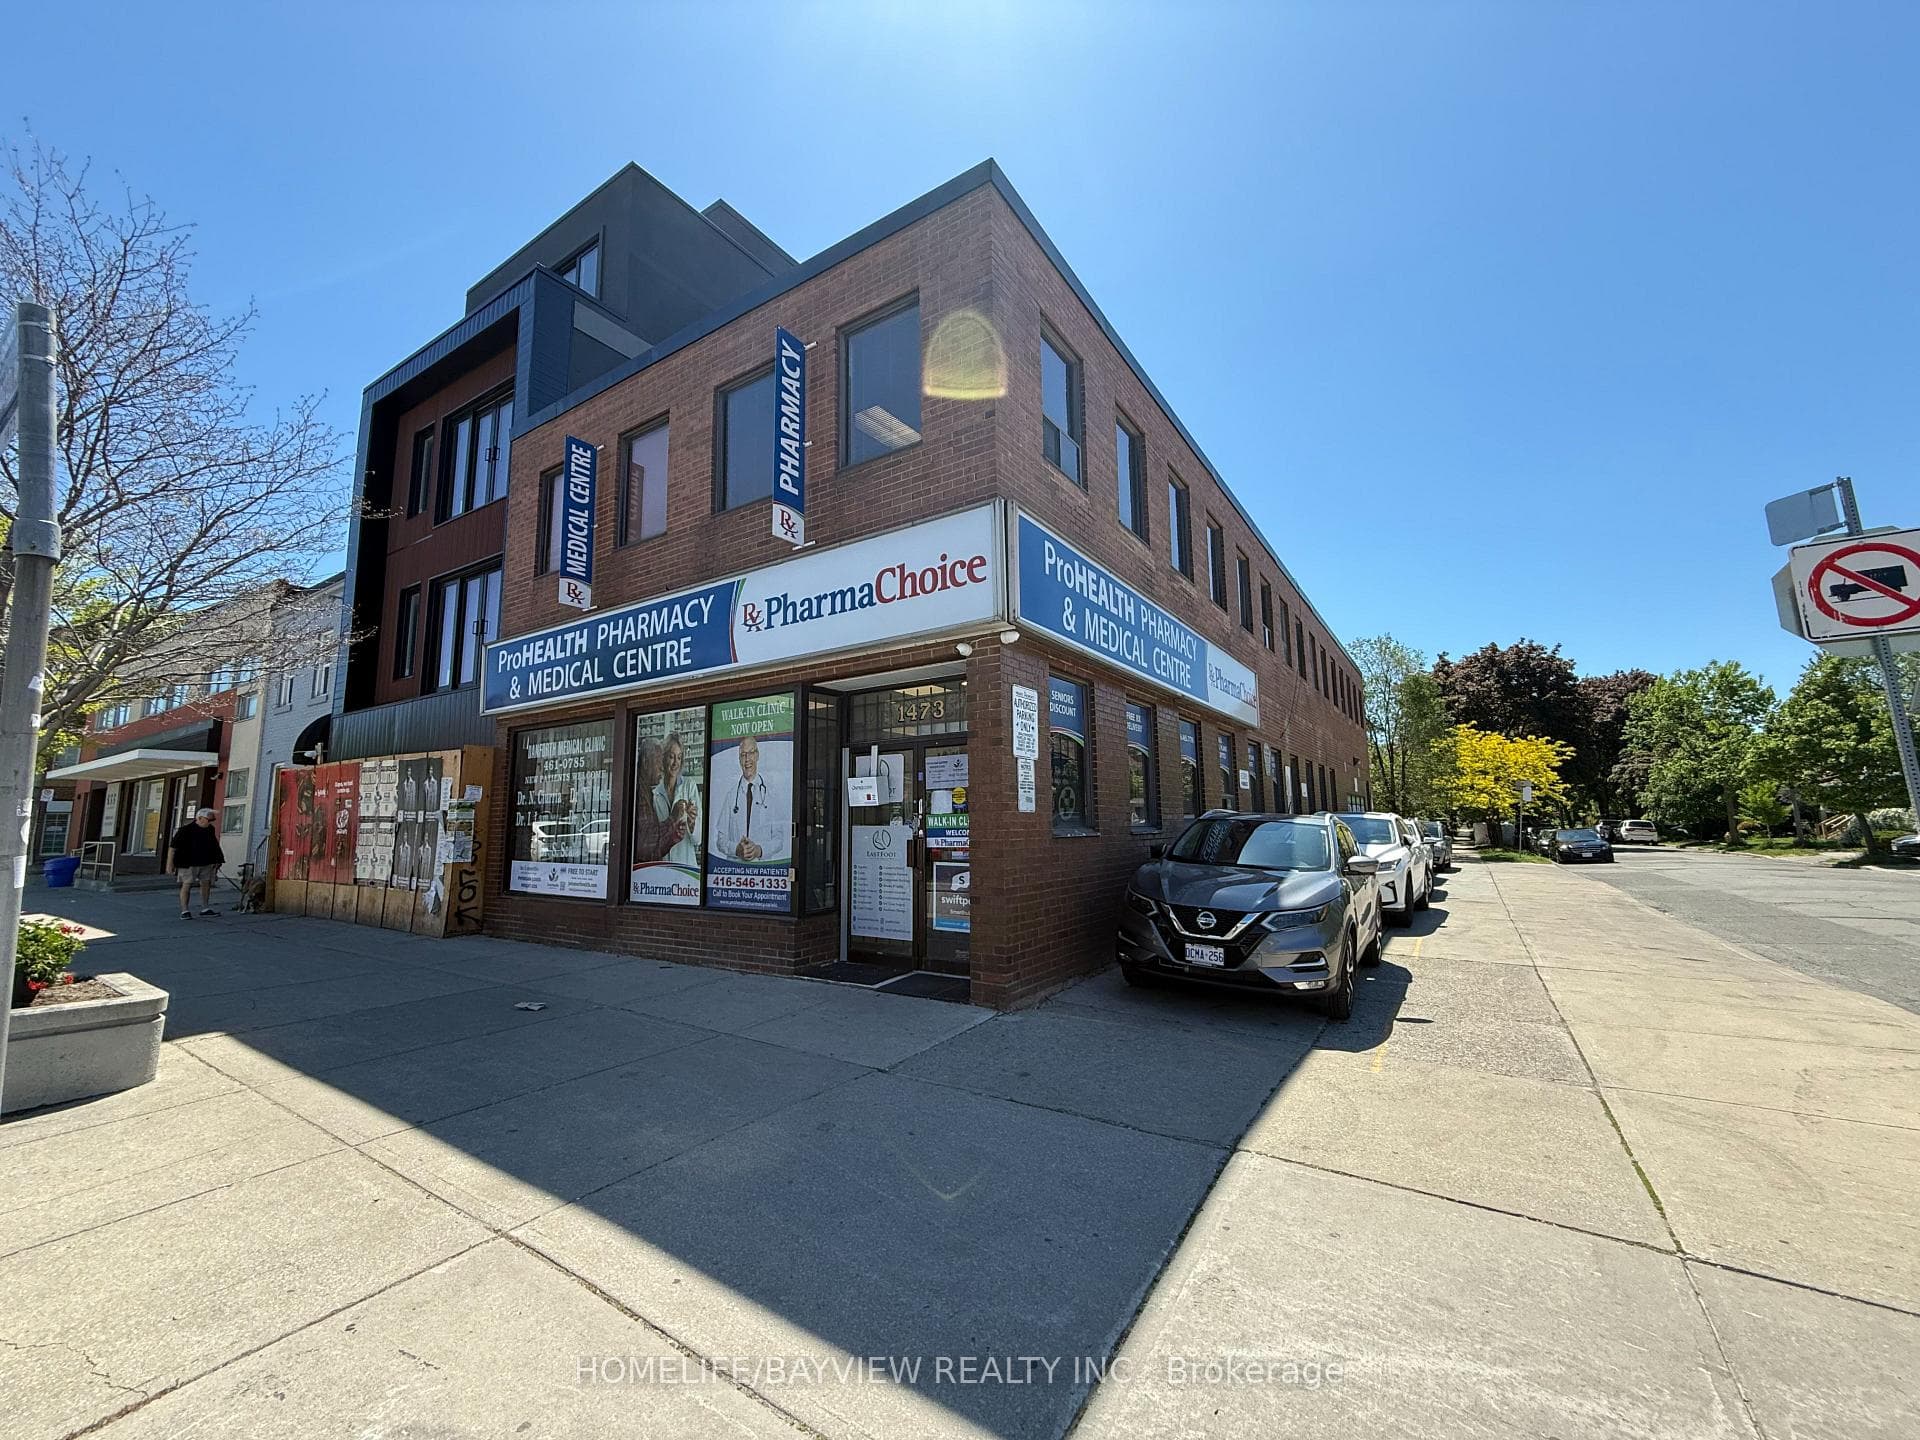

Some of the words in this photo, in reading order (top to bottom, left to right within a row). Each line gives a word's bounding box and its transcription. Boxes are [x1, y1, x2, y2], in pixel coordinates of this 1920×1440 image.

[778, 337, 802, 497] PHARMACY
[569, 444, 592, 504] CENTRE
[566, 509, 589, 577] MEDICAL
[764, 553, 987, 631] PharmaChoice
[1043, 540, 1135, 626] ProHEALTH
[1140, 603, 1198, 662] PHARMACY
[497, 628, 588, 673] ProHEALTH
[596, 594, 715, 649] PHARMACY
[1062, 596, 1076, 634] &
[1084, 607, 1148, 668] MEDICAL
[1152, 646, 1192, 689] CENTRE
[509, 676, 521, 700] &
[528, 657, 604, 696] MEDICAL
[612, 636, 692, 679] CENTRE
[1051, 690, 1074, 705] SENIORS
[721, 705, 756, 721] WALK-IN
[757, 701, 786, 717] CLINIC
[897, 700, 945, 722] 1473
[1017, 709, 1035, 722] PARKING
[1049, 701, 1077, 717] DISCOUNT
[730, 722, 750, 736] NOW
[751, 720, 774, 733] OPEN
[1020, 721, 1031, 732] ONLY
[557, 737, 584, 756] MEDICAL
[584, 735, 606, 753] CLINIC
[543, 756, 585, 771] 461-0785
[927, 816, 957, 827] WALK-IN
[713, 866, 745, 874] ACCEPTING
[745, 867, 759, 875] NEW
[640, 882, 699, 898] PharmaChoice
[712, 876, 788, 889] 416-546-1333
[712, 889, 721, 897] Call
[728, 890, 740, 898] Book
[741, 890, 753, 898] Your
[753, 892, 787, 901] Appointment
[1208, 950, 1224, 963] 256
